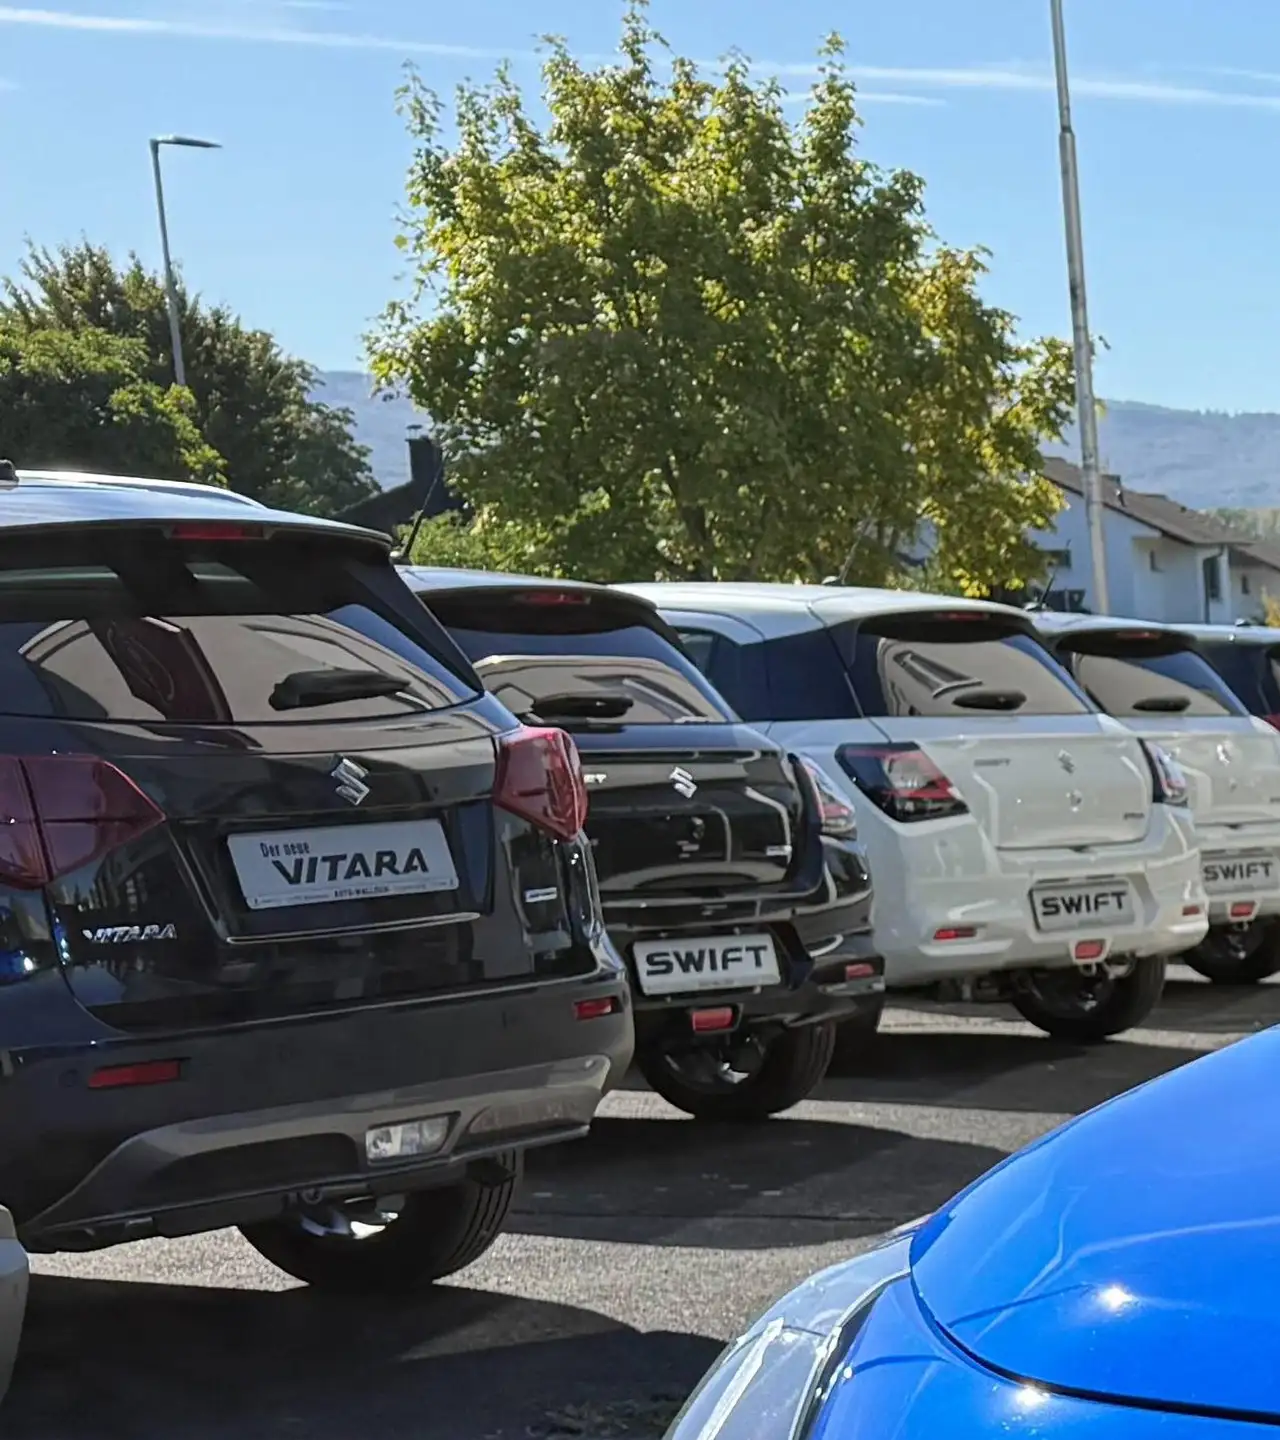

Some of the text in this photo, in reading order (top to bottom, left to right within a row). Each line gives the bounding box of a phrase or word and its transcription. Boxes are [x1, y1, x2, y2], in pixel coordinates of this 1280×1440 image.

[260, 842, 279, 858] Der
[272, 848, 429, 885] VITARA
[1203, 861, 1274, 881] SWIFT
[1041, 890, 1128, 916] SWIFT
[645, 944, 768, 977] SWIFT
